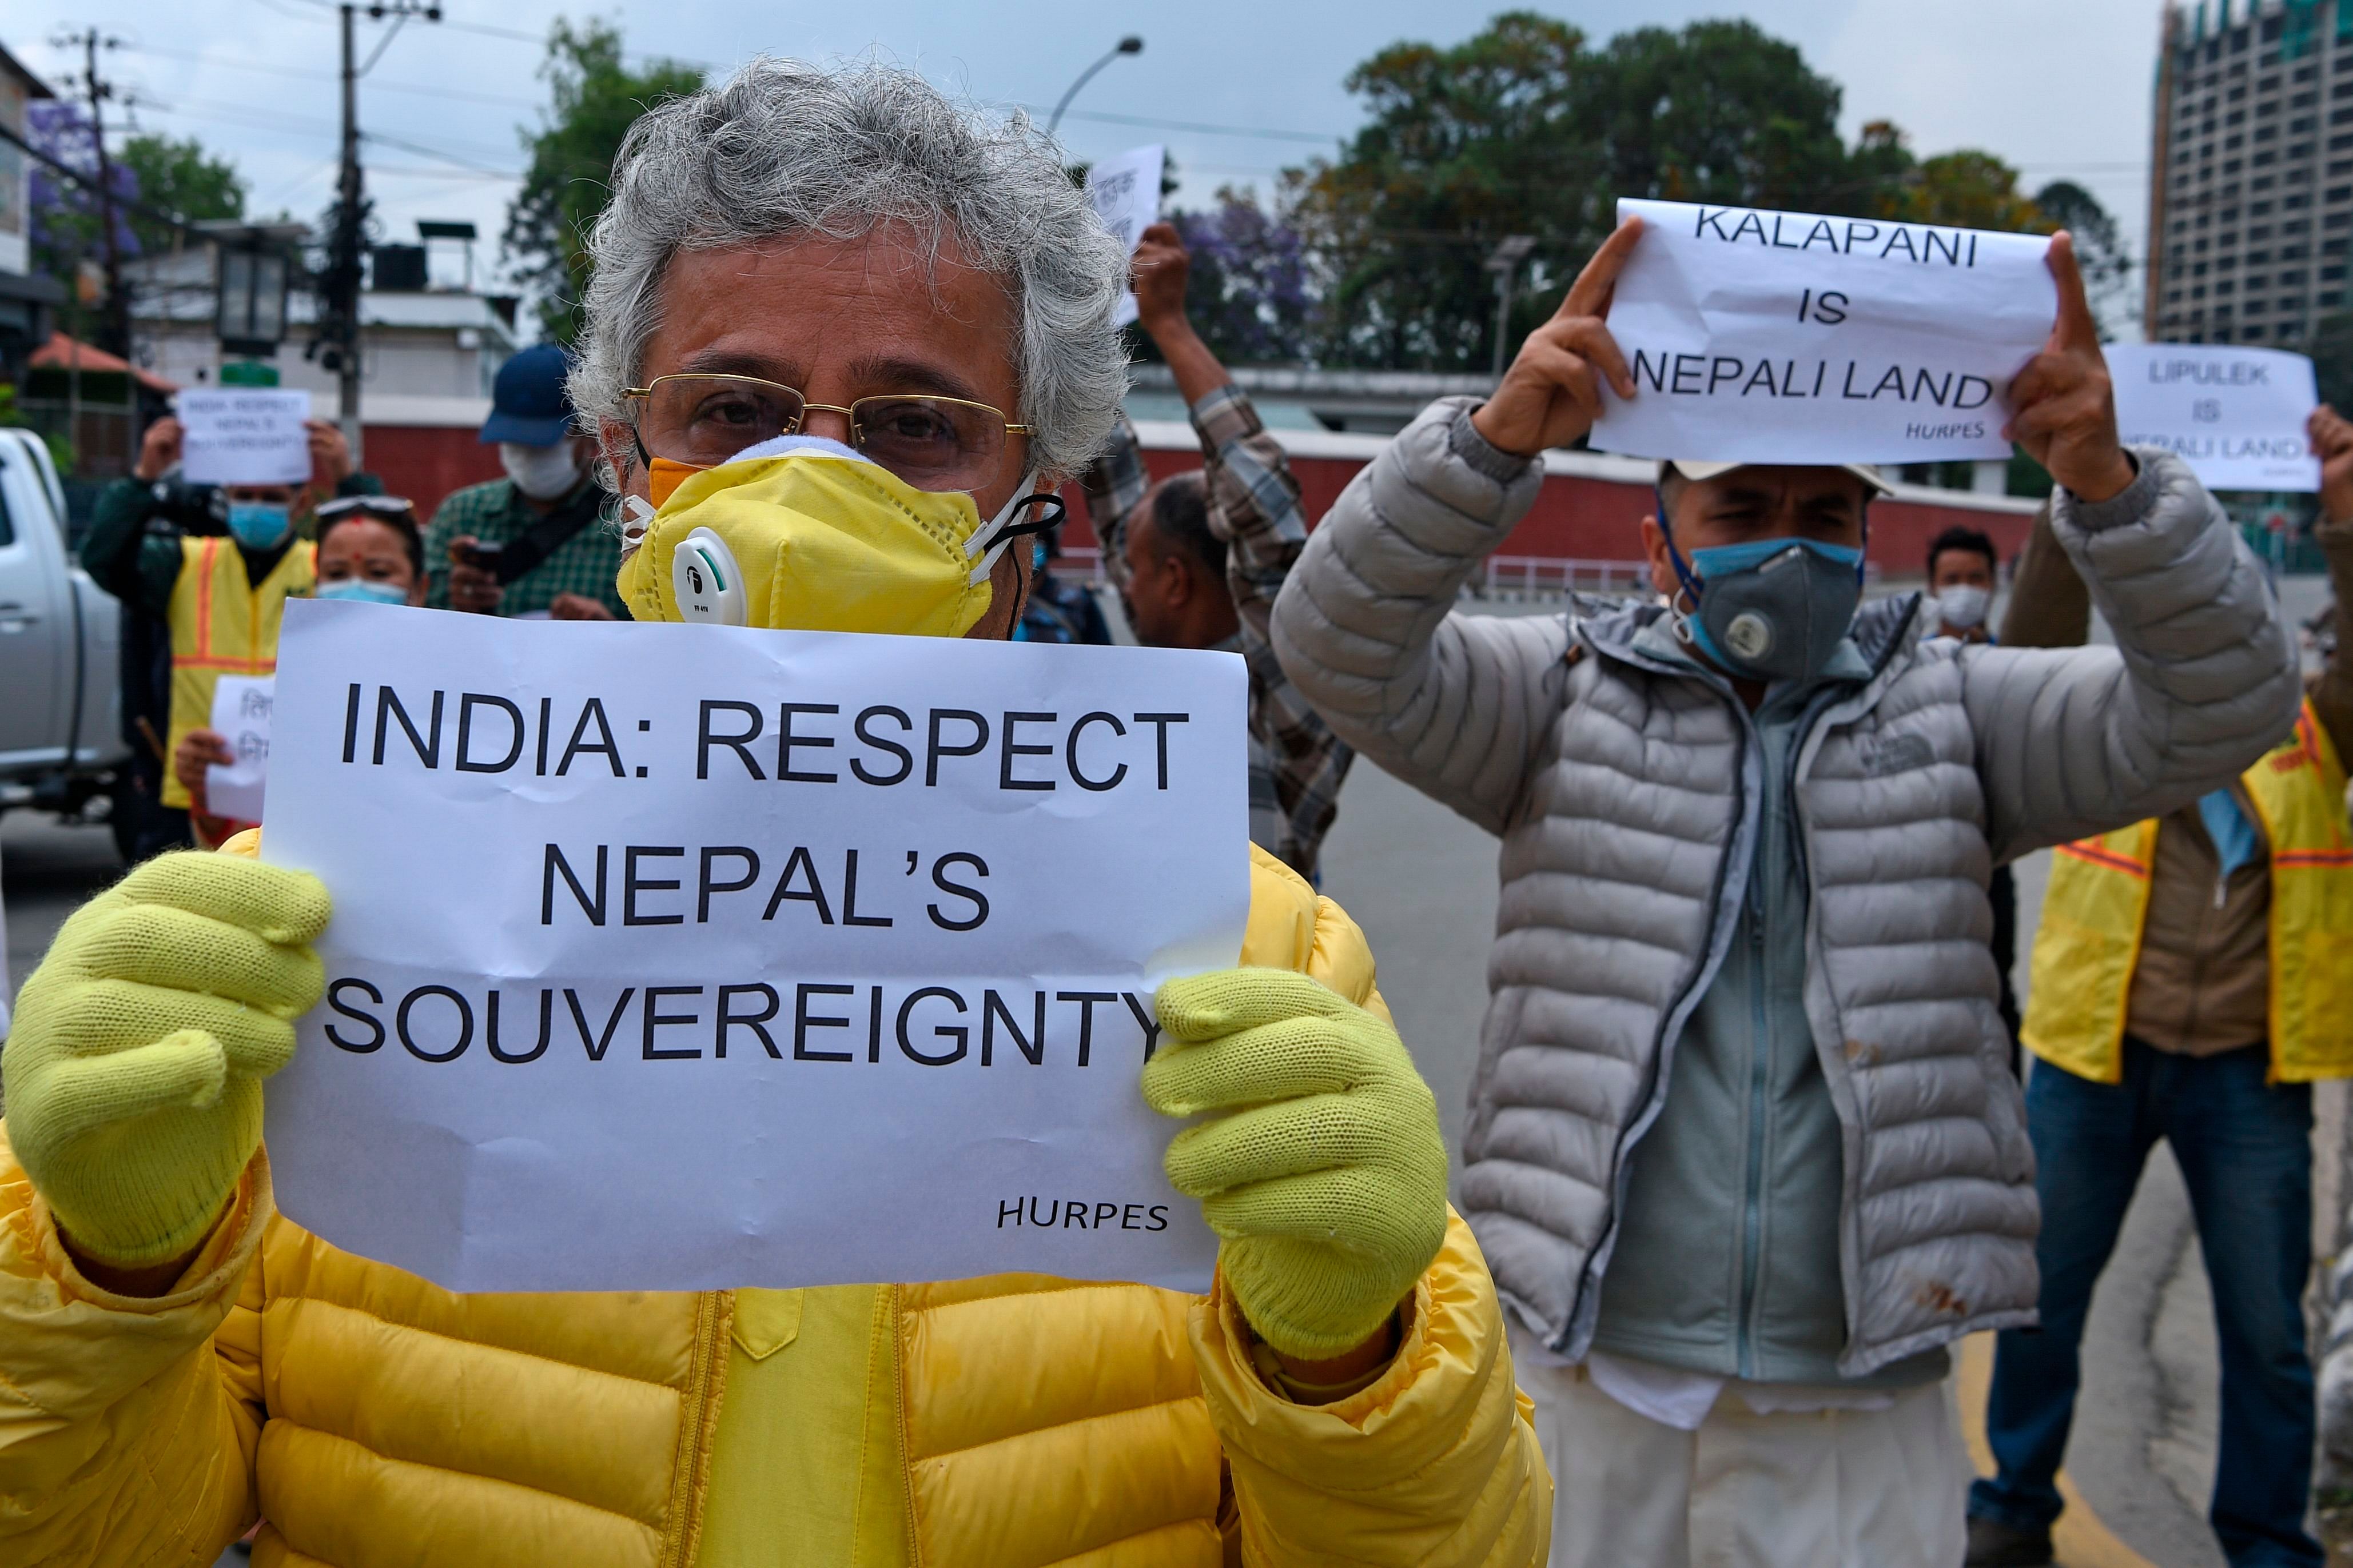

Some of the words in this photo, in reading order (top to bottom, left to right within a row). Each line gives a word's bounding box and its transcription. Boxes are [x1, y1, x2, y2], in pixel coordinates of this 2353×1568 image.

[1695, 207, 1977, 267] KALAPANI
[1798, 289, 1850, 326] IS
[1633, 349, 1826, 398] NEPALI
[1842, 360, 1993, 410] LAND
[2148, 360, 2269, 386] LIPULEK
[2192, 399, 2221, 423] IS
[1906, 421, 1985, 440] HURPES
[2220, 436, 2303, 460] LAND
[343, 683, 650, 778] INDIA:
[696, 700, 1189, 792] RESPECT
[541, 843, 990, 932] NEPAL’S
[323, 977, 1163, 1067] SOUVEREIGNTY
[997, 1196, 1169, 1231] HURPES
